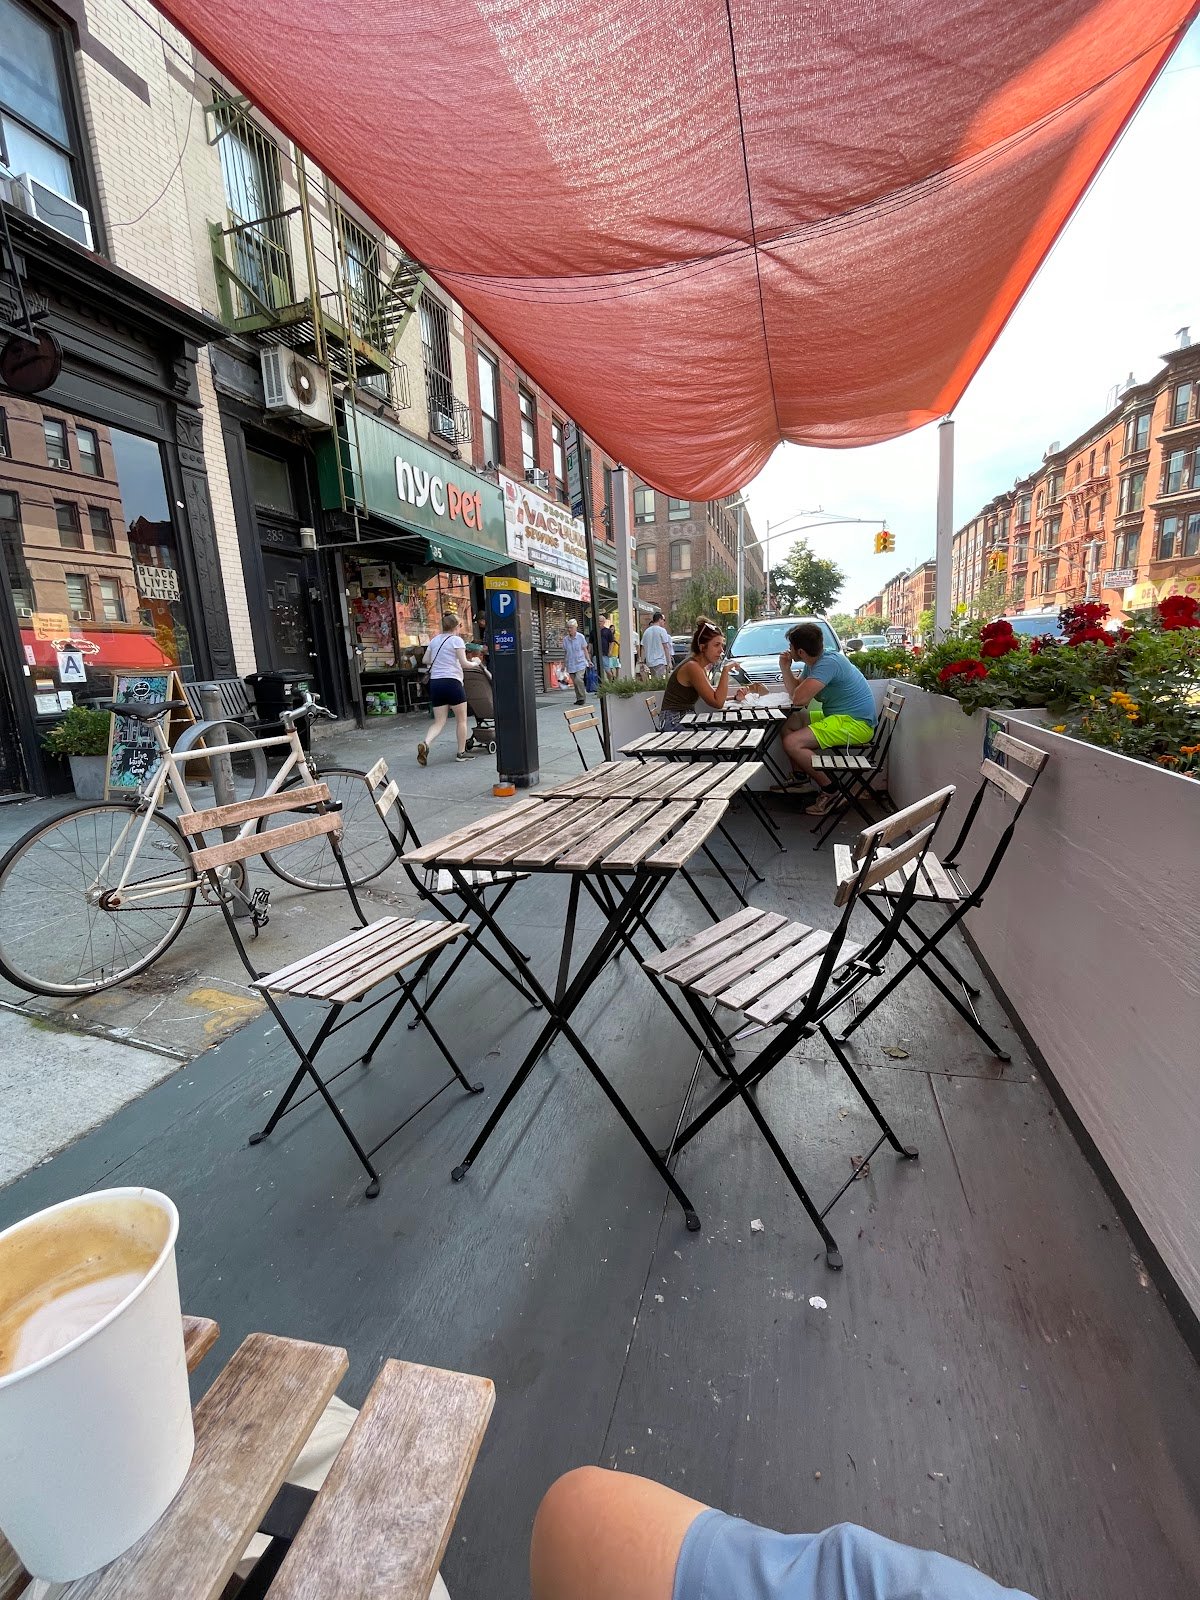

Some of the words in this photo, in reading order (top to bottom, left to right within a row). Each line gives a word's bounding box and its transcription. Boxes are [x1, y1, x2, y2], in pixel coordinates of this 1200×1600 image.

[395, 455, 445, 516] nyc
[447, 482, 483, 531] pet
[266, 529, 284, 542] 385
[139, 566, 175, 579] BLACK
[143, 577, 175, 590] LIVES
[141, 588, 180, 600] MATTER
[499, 593, 512, 614] P
[64, 655, 81, 674] A
